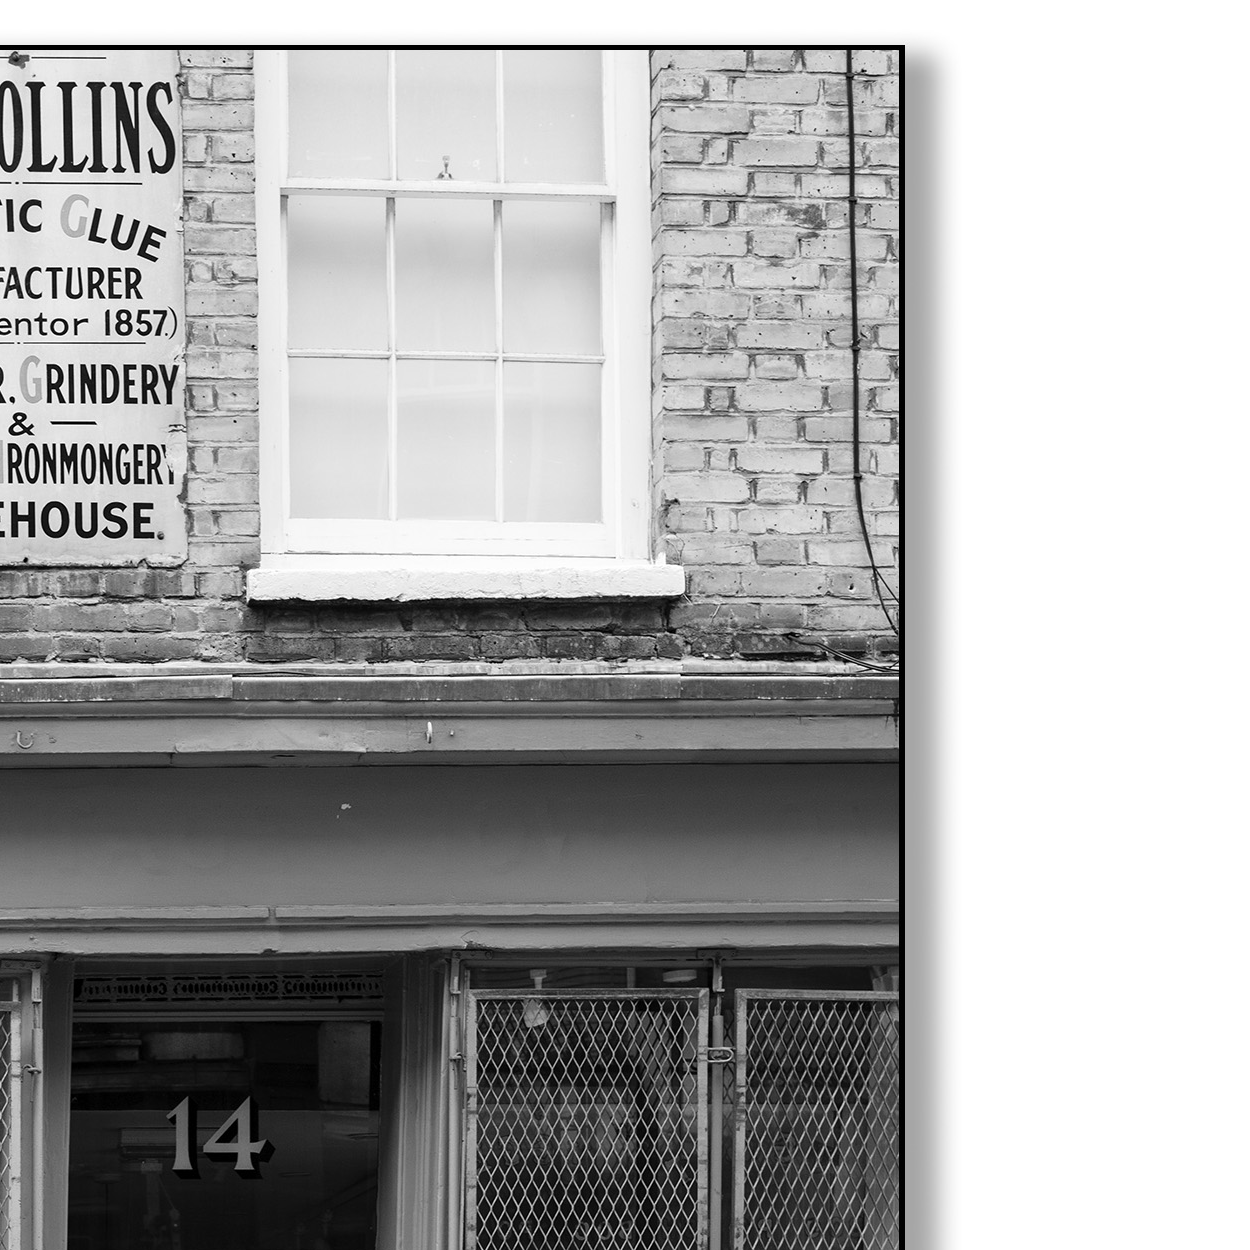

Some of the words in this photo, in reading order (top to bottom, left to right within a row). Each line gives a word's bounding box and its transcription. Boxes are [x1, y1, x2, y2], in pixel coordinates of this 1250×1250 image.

[60, 193, 167, 263] GLUE
[19, 355, 180, 405] GRINDERY
[8, 412, 35, 436] &
[166, 1096, 272, 1174] 14
